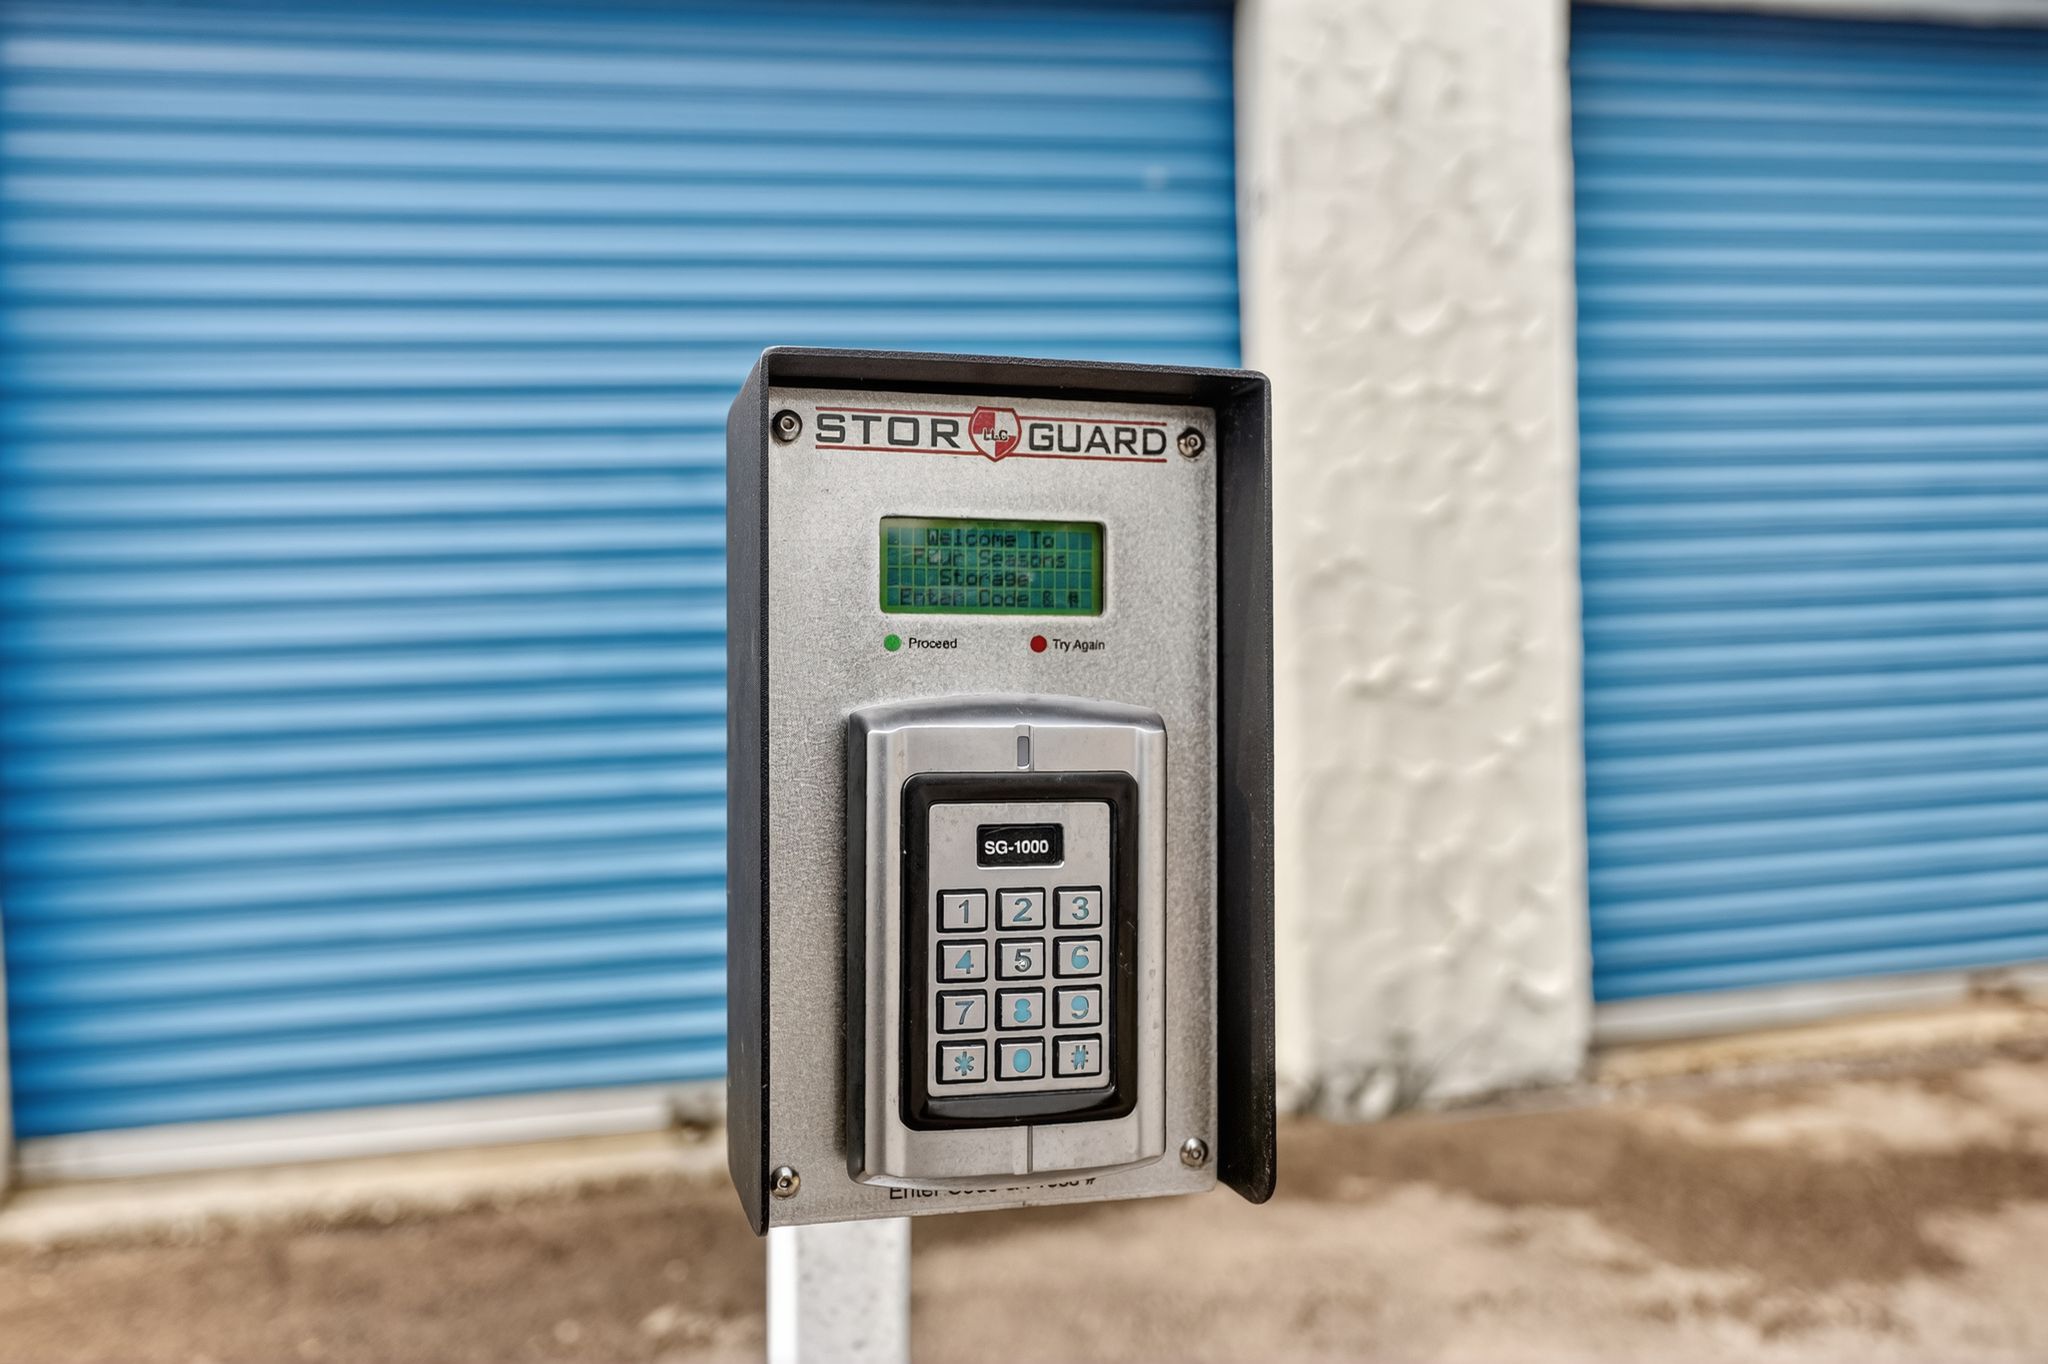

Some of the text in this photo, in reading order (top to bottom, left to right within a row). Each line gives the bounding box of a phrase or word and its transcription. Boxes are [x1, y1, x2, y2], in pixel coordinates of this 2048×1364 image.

[816, 413, 1167, 455] STOR GUARD
[928, 529, 1055, 548] Welcome To
[979, 549, 1066, 568] Seasons
[940, 568, 1029, 587] Storage
[900, 588, 965, 606] Enter
[979, 589, 1029, 607] Code
[908, 637, 958, 649] Proceed
[1053, 639, 1106, 652] Try Again
[984, 840, 1049, 854] SG-1000
[958, 900, 970, 924] 1
[1012, 898, 1033, 922] 2
[1071, 896, 1090, 920] 3
[955, 950, 974, 974] 4
[1014, 948, 1032, 973] 5
[1070, 945, 1090, 969] 6
[955, 1000, 975, 1025] 7
[1013, 998, 1032, 1023] 8
[1071, 995, 1090, 1020] 9
[1013, 1048, 1032, 1073] 0
